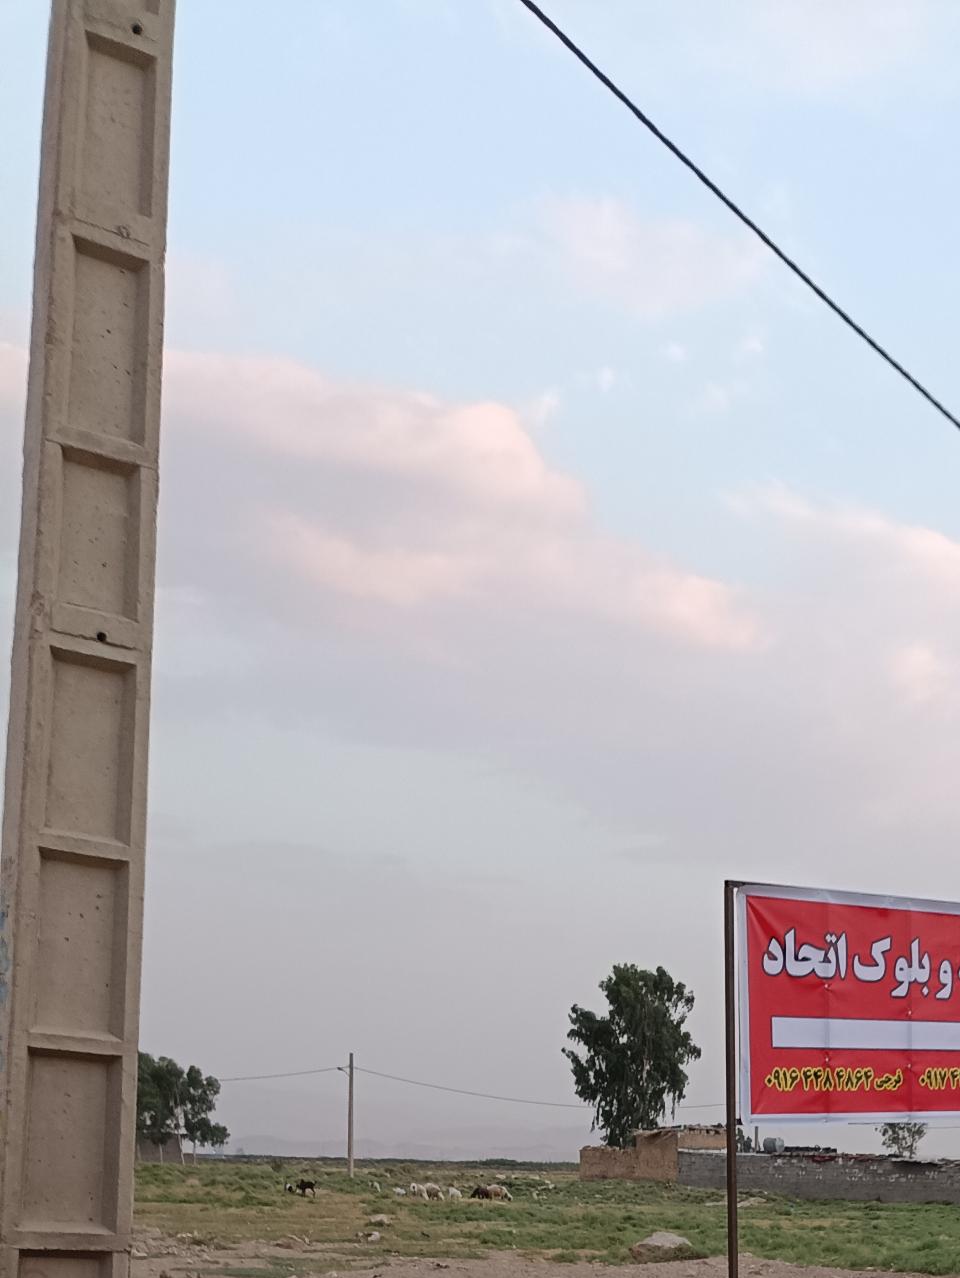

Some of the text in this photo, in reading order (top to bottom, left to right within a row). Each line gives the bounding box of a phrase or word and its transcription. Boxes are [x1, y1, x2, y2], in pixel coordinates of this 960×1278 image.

[762, 927, 848, 980] اتحاد
[852, 935, 931, 999] بلوک
[934, 958, 953, 1000] و
